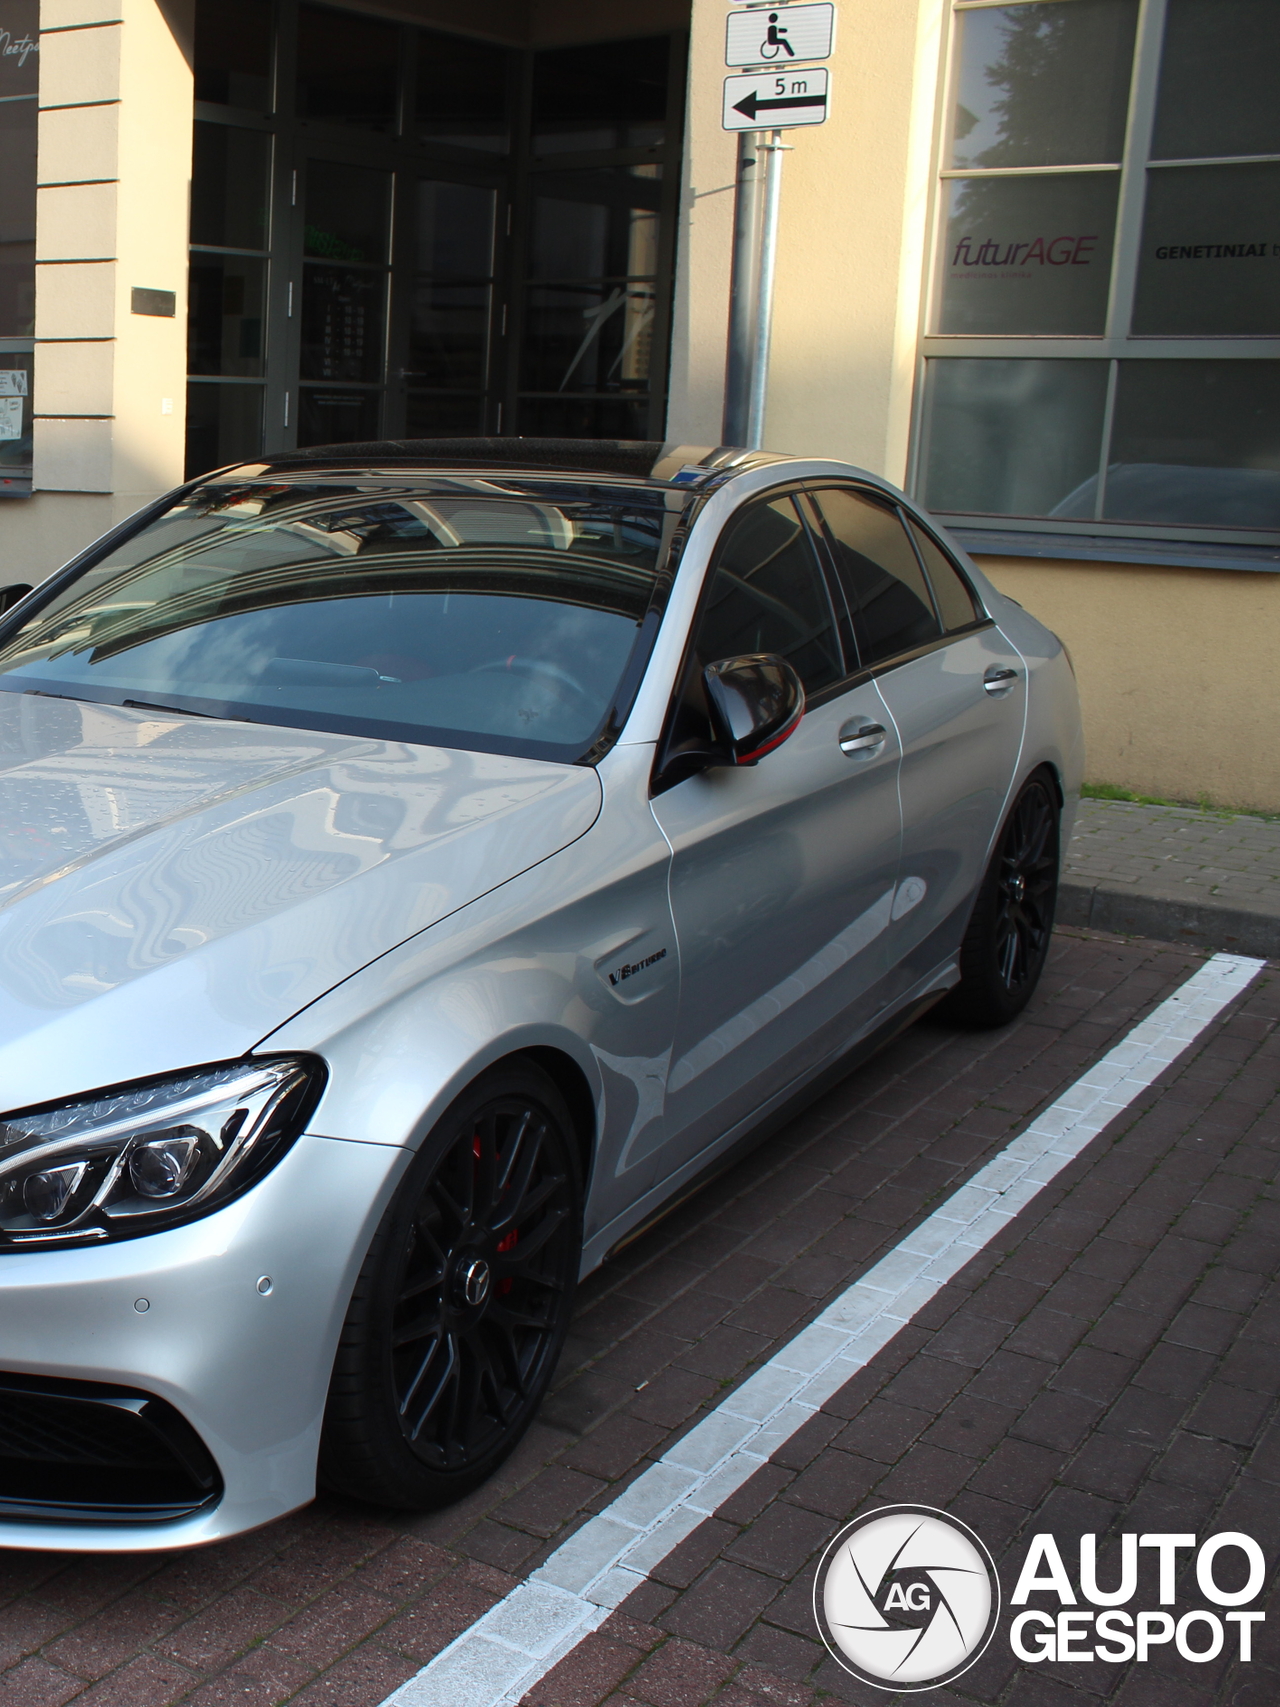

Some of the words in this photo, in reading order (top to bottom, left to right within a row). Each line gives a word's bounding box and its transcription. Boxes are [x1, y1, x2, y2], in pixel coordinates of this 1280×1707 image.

[774, 77, 786, 96] 5
[791, 80, 808, 94] m
[951, 235, 1099, 266] futurAGE
[1155, 243, 1267, 260] GENETINIAI
